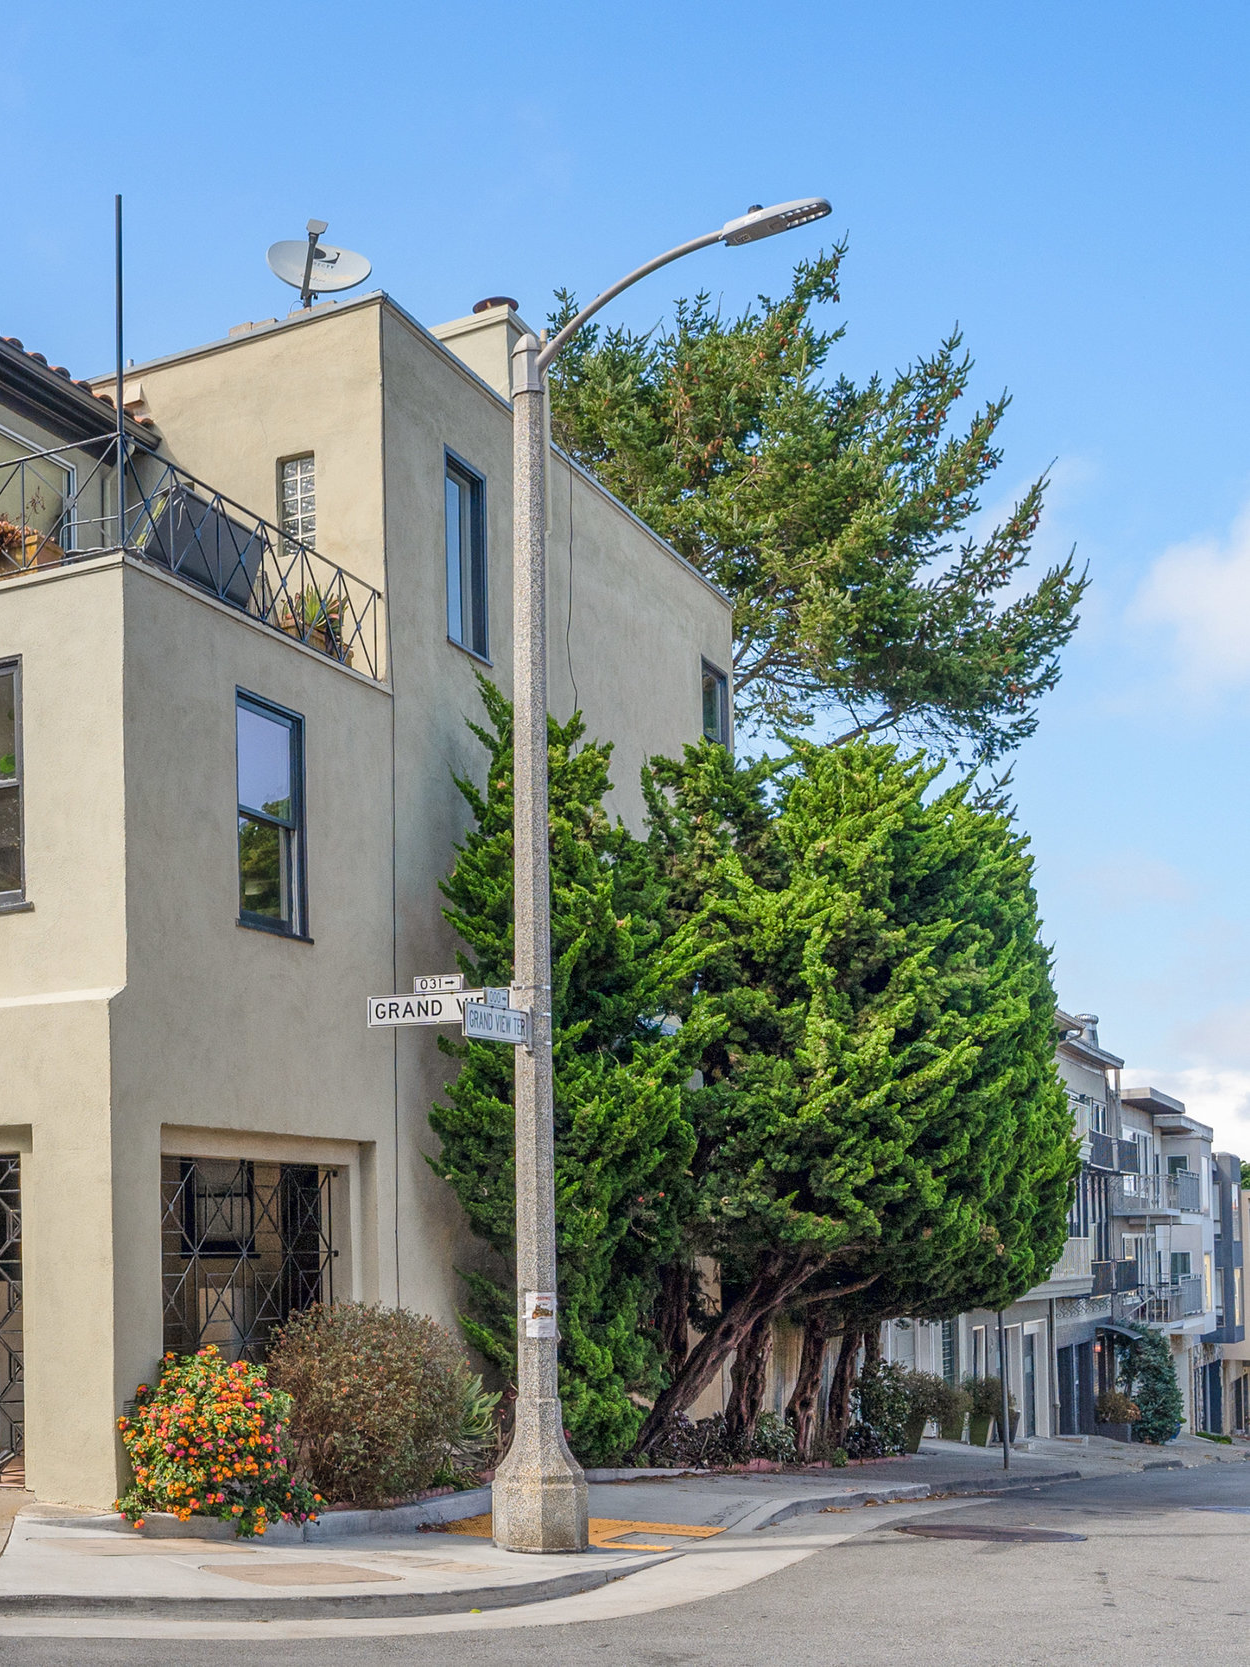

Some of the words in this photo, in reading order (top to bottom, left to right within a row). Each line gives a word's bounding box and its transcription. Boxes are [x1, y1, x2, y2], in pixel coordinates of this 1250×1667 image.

[420, 978, 442, 990] 031
[375, 999, 442, 1019] GRAND
[469, 1010, 493, 1030] GRAND
[495, 1014, 511, 1034] VIEW
[513, 1017, 526, 1036] TER
